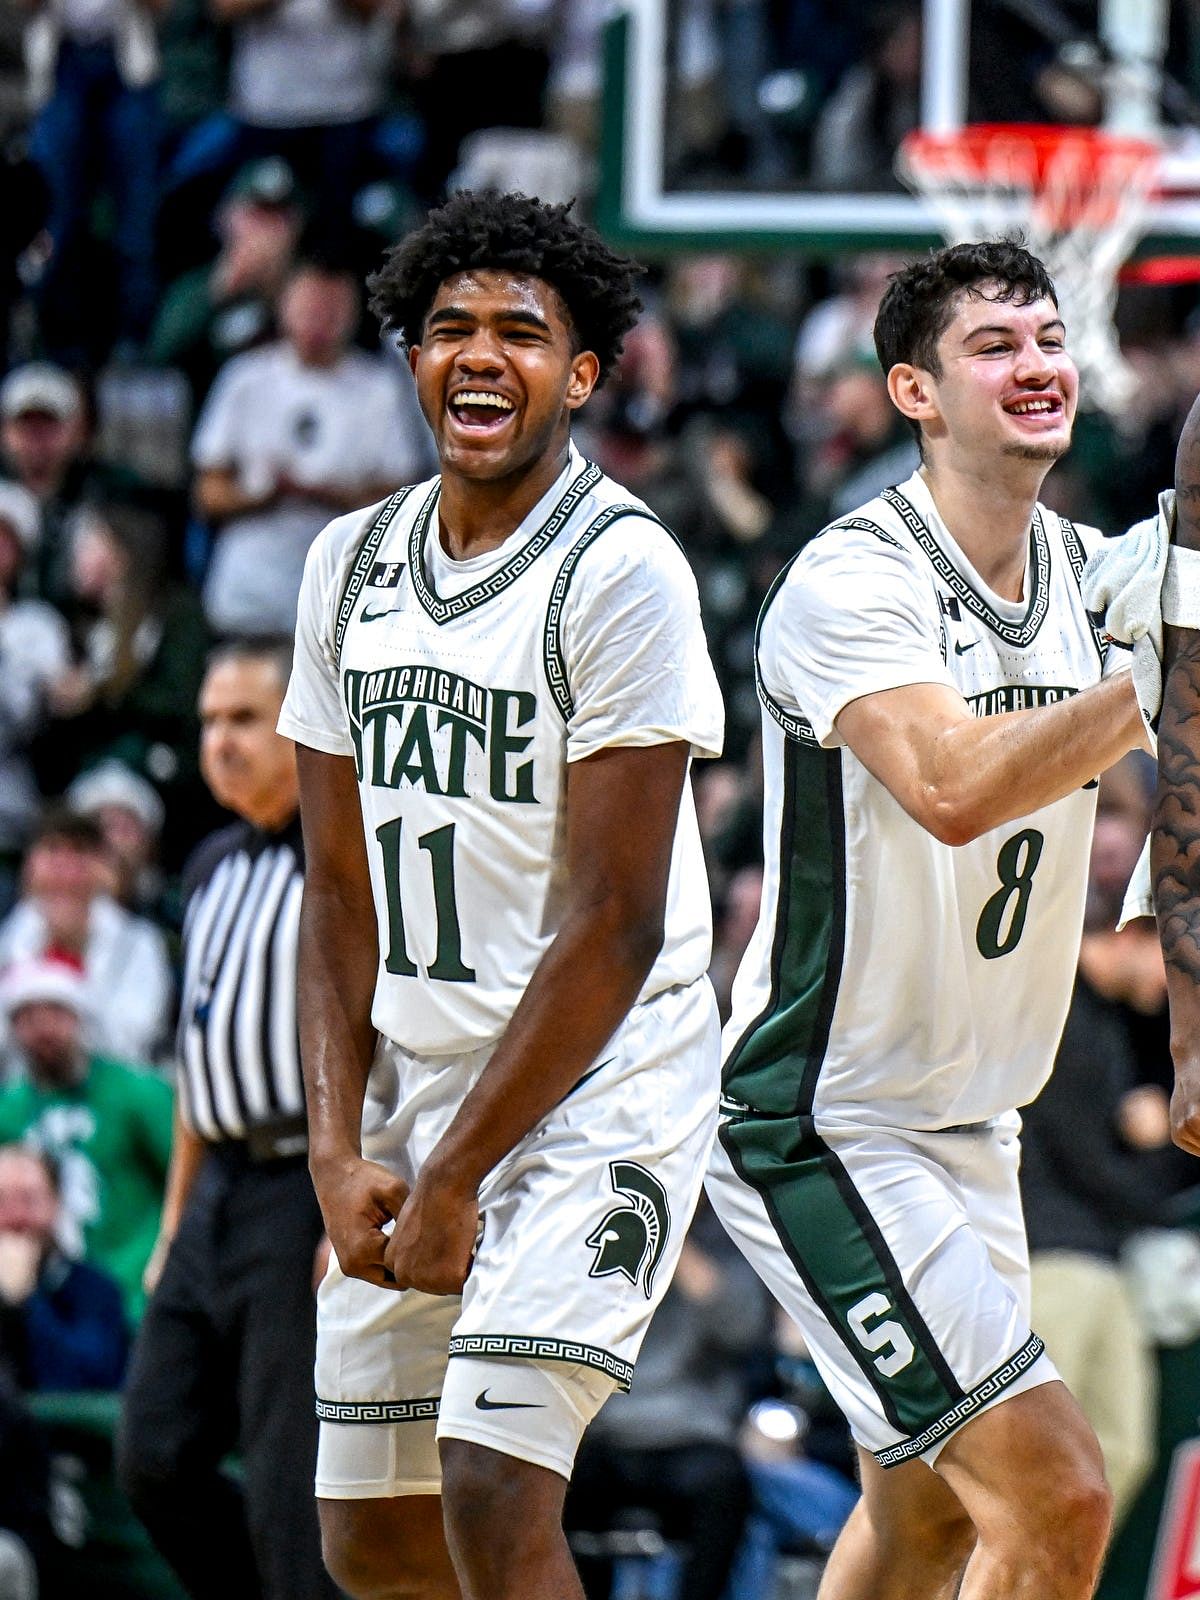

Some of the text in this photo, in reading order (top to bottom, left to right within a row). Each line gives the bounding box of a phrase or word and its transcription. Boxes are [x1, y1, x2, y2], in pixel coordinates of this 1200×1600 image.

[374, 563, 400, 587] JF
[344, 668, 541, 804] STATE
[365, 668, 483, 720] MICHIGAN
[968, 688, 1074, 718] MICHI
[376, 817, 477, 982] 11
[976, 828, 1044, 960] 8
[846, 1292, 915, 1378] S
